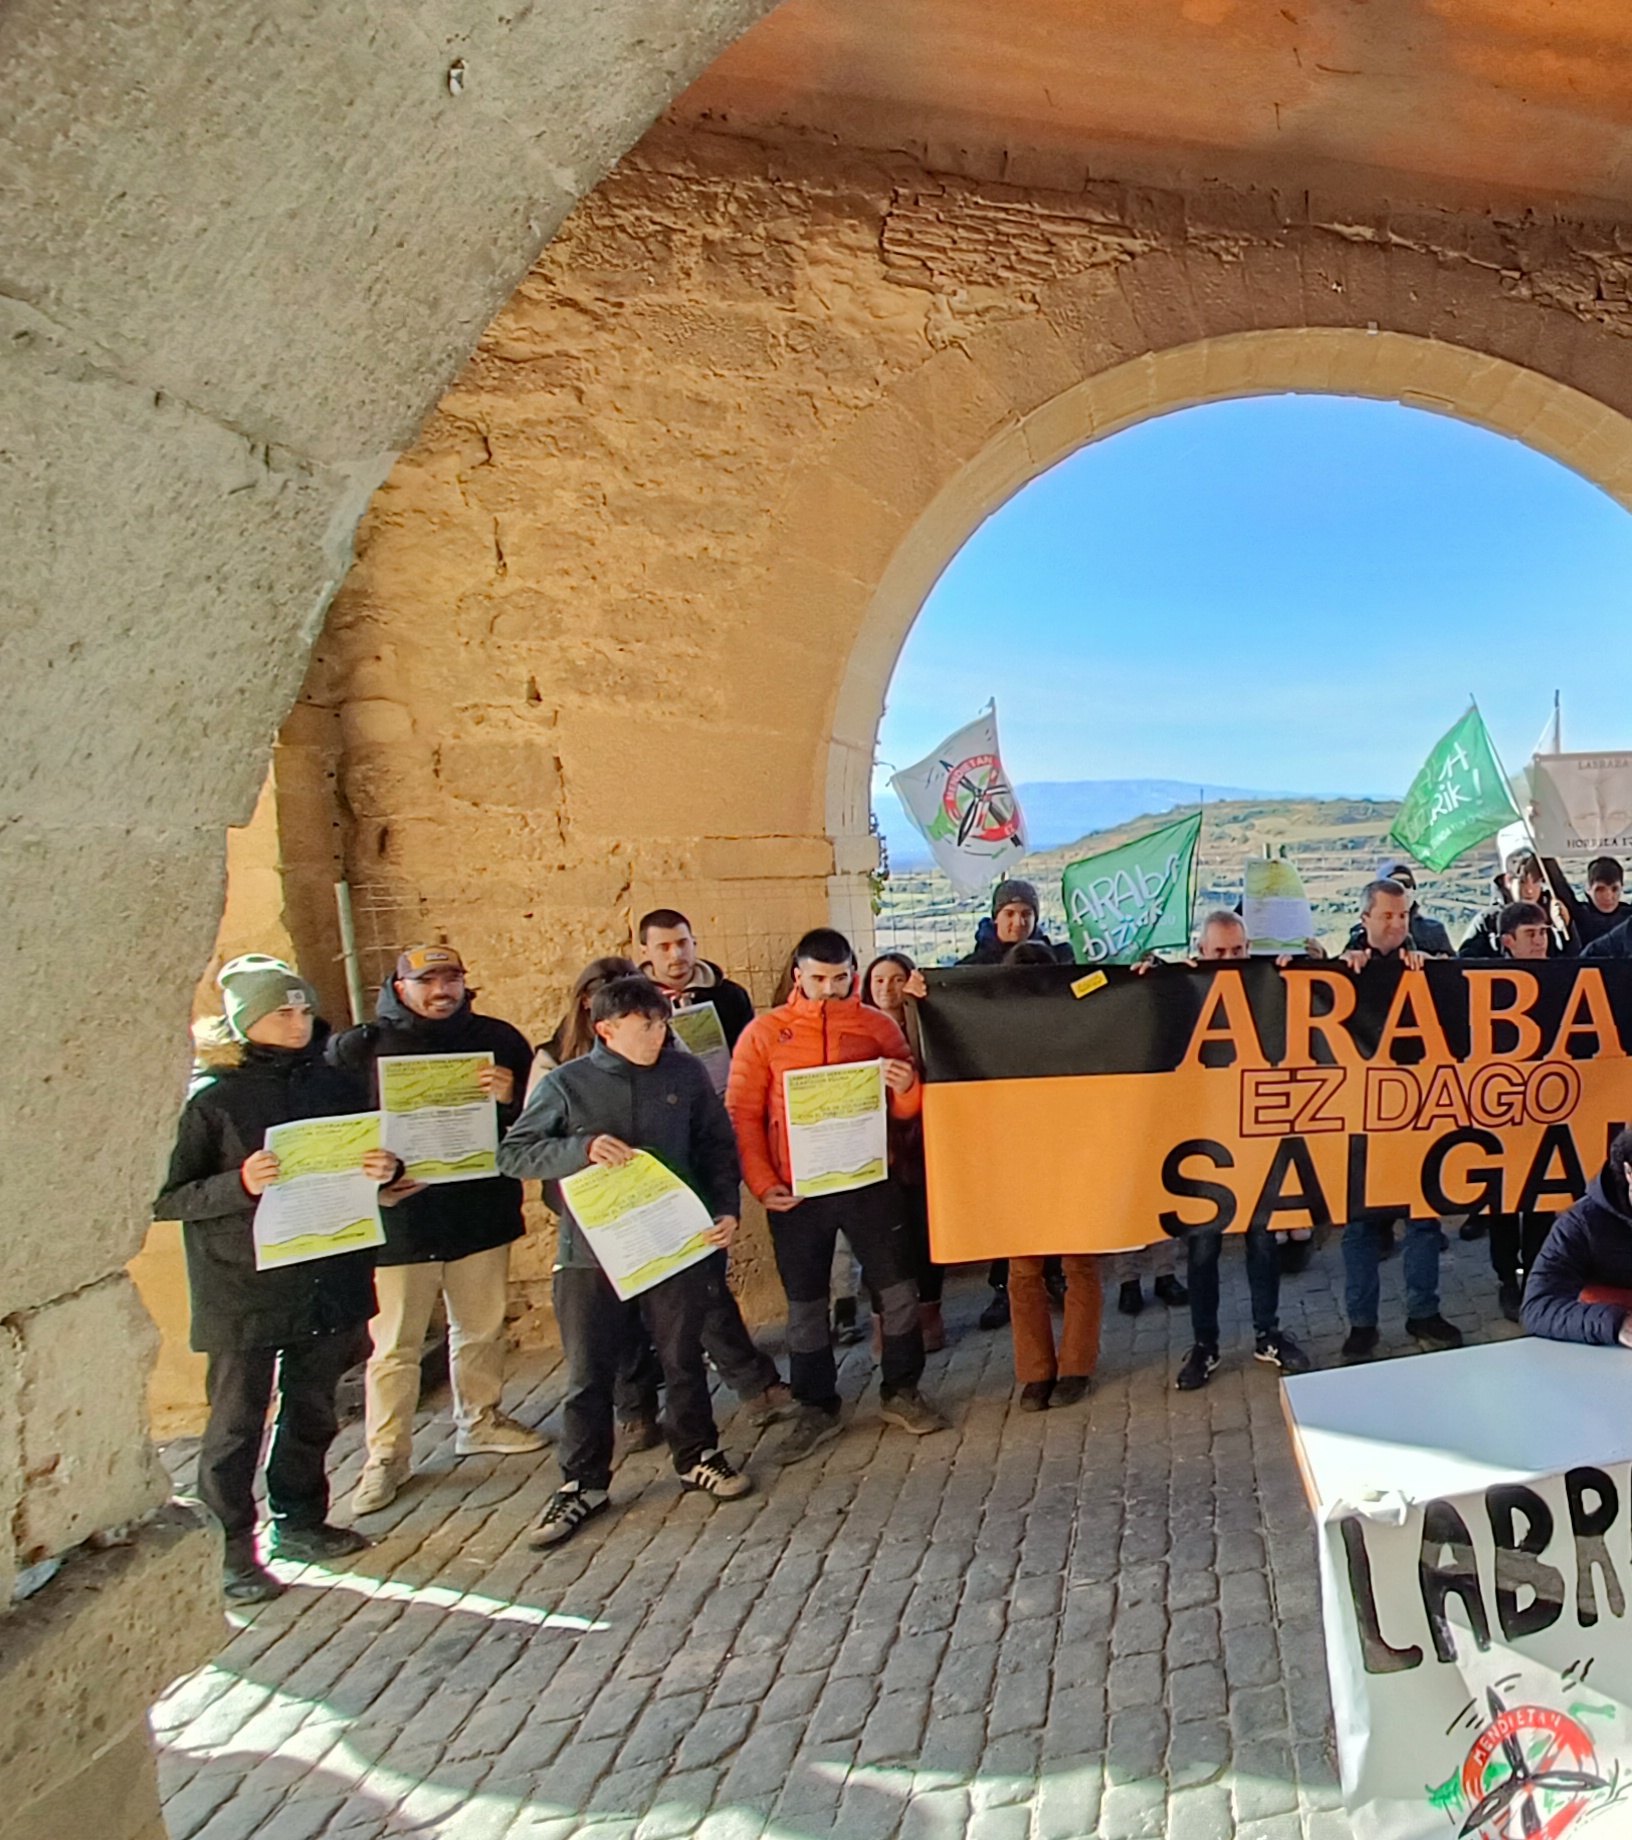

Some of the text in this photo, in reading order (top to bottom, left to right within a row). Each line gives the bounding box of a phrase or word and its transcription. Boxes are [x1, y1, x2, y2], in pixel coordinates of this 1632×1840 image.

[1577, 759, 1630, 770] LABRAZA
[1174, 967, 1628, 1073] ARABA
[1239, 1060, 1582, 1138] EZ DAGO
[1473, 1708, 1562, 1768] MENDIETAN
